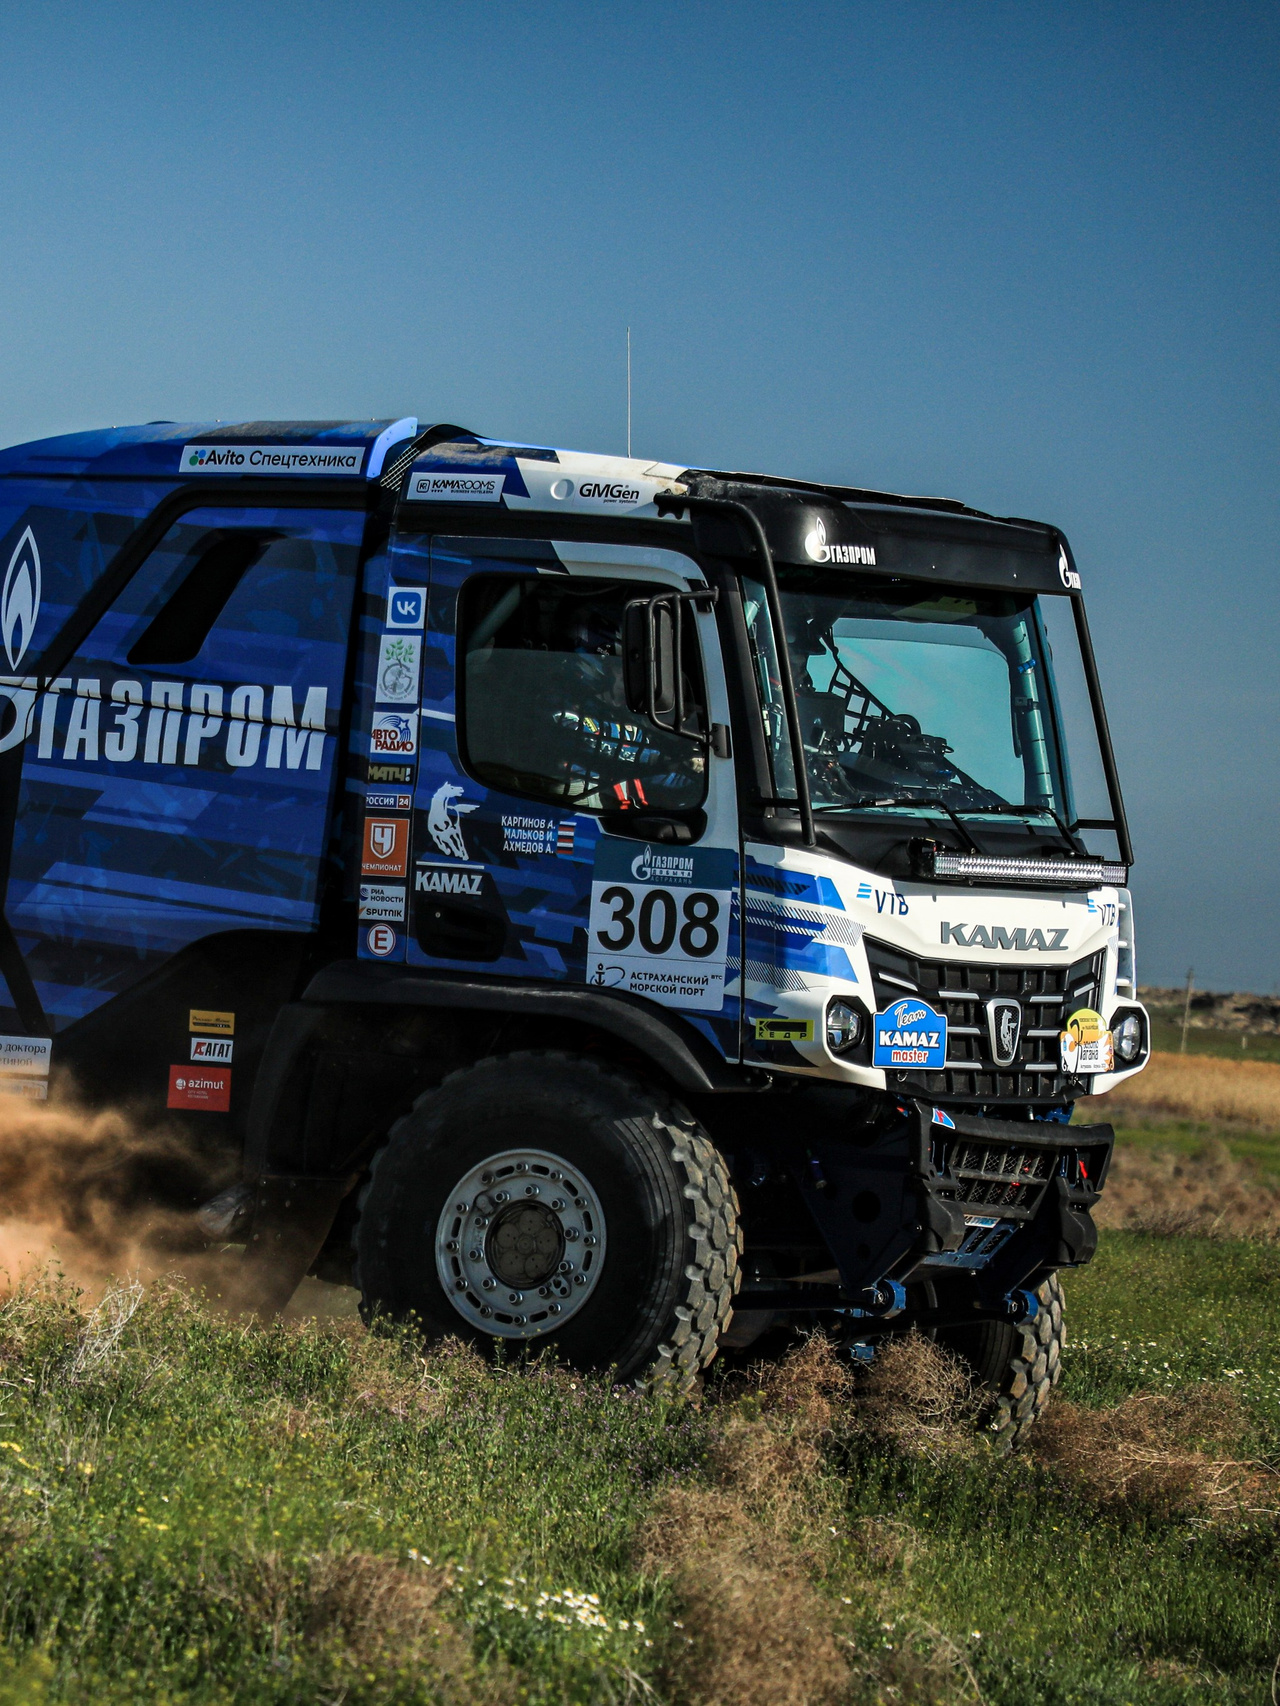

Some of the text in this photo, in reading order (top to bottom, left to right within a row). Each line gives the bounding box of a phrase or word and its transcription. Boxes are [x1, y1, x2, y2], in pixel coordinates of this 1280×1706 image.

[205, 450, 357, 469] Avito Спецтехника
[432, 479, 496, 491] KAMAROOMS
[579, 483, 640, 499] GMGen
[830, 545, 877, 566] ГАЗПРОМ
[37, 676, 329, 771] ГАЗПРОМ
[375, 741, 414, 752] РАДИО
[399, 798, 410, 806] 24
[501, 815, 556, 829] КАРГИНОВ А.
[503, 828, 555, 842] МАЛЬКОВ И.
[502, 841, 554, 854] АХМЕДОВ А.
[651, 856, 694, 870] ГАЗПРОМ
[414, 871, 483, 896] KAMAZ
[650, 876, 693, 885] АСТРАХАНЬ
[370, 896, 404, 904] НОВОСТИ
[875, 889, 910, 916] VTB
[597, 886, 720, 959] 308
[374, 929, 389, 951] E
[940, 921, 1070, 952] KAMAZ
[630, 971, 709, 986] АСТРАХАНСКИЙ
[629, 983, 706, 997] МОРСКОЙ ПОРТ
[894, 1003, 927, 1029] Team
[879, 1030, 940, 1048] KAMAZ
[4, 1043, 47, 1056] доктора
[892, 1049, 929, 1063] master
[188, 1078, 224, 1090] azimut
